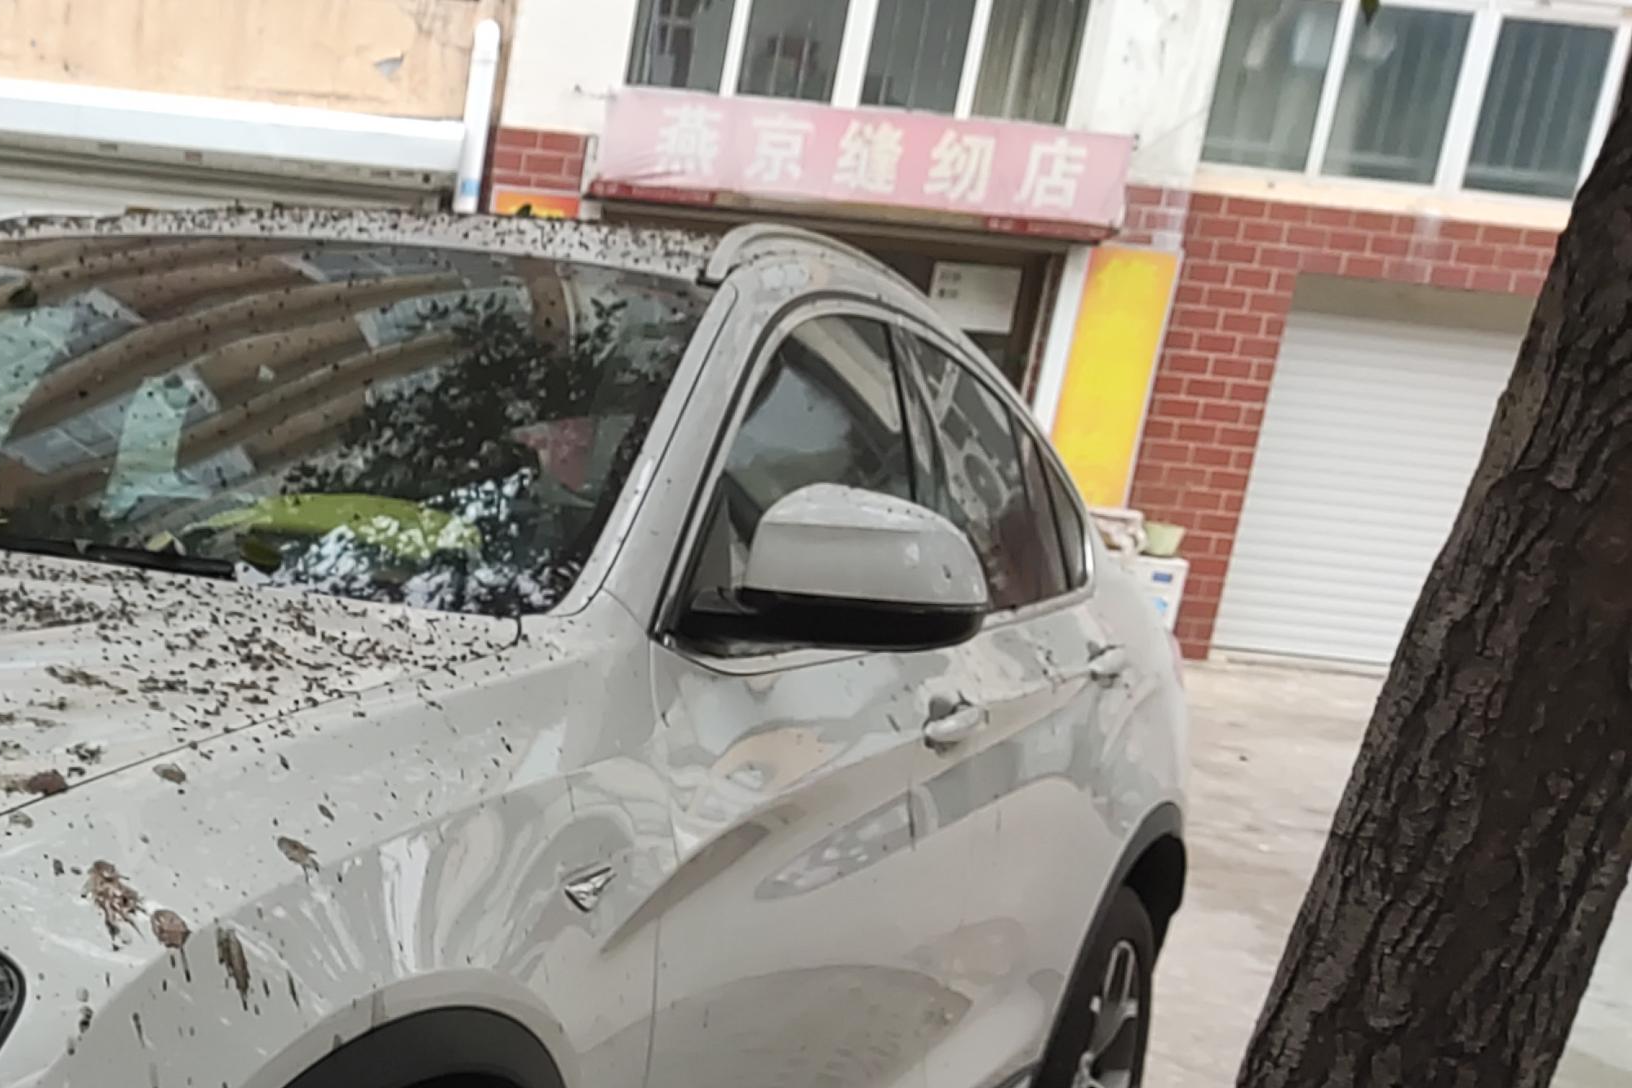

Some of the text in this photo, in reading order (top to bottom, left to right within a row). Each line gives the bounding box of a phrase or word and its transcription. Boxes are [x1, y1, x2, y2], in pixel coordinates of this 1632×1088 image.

[656, 104, 1089, 209] 燕京缝纫店
